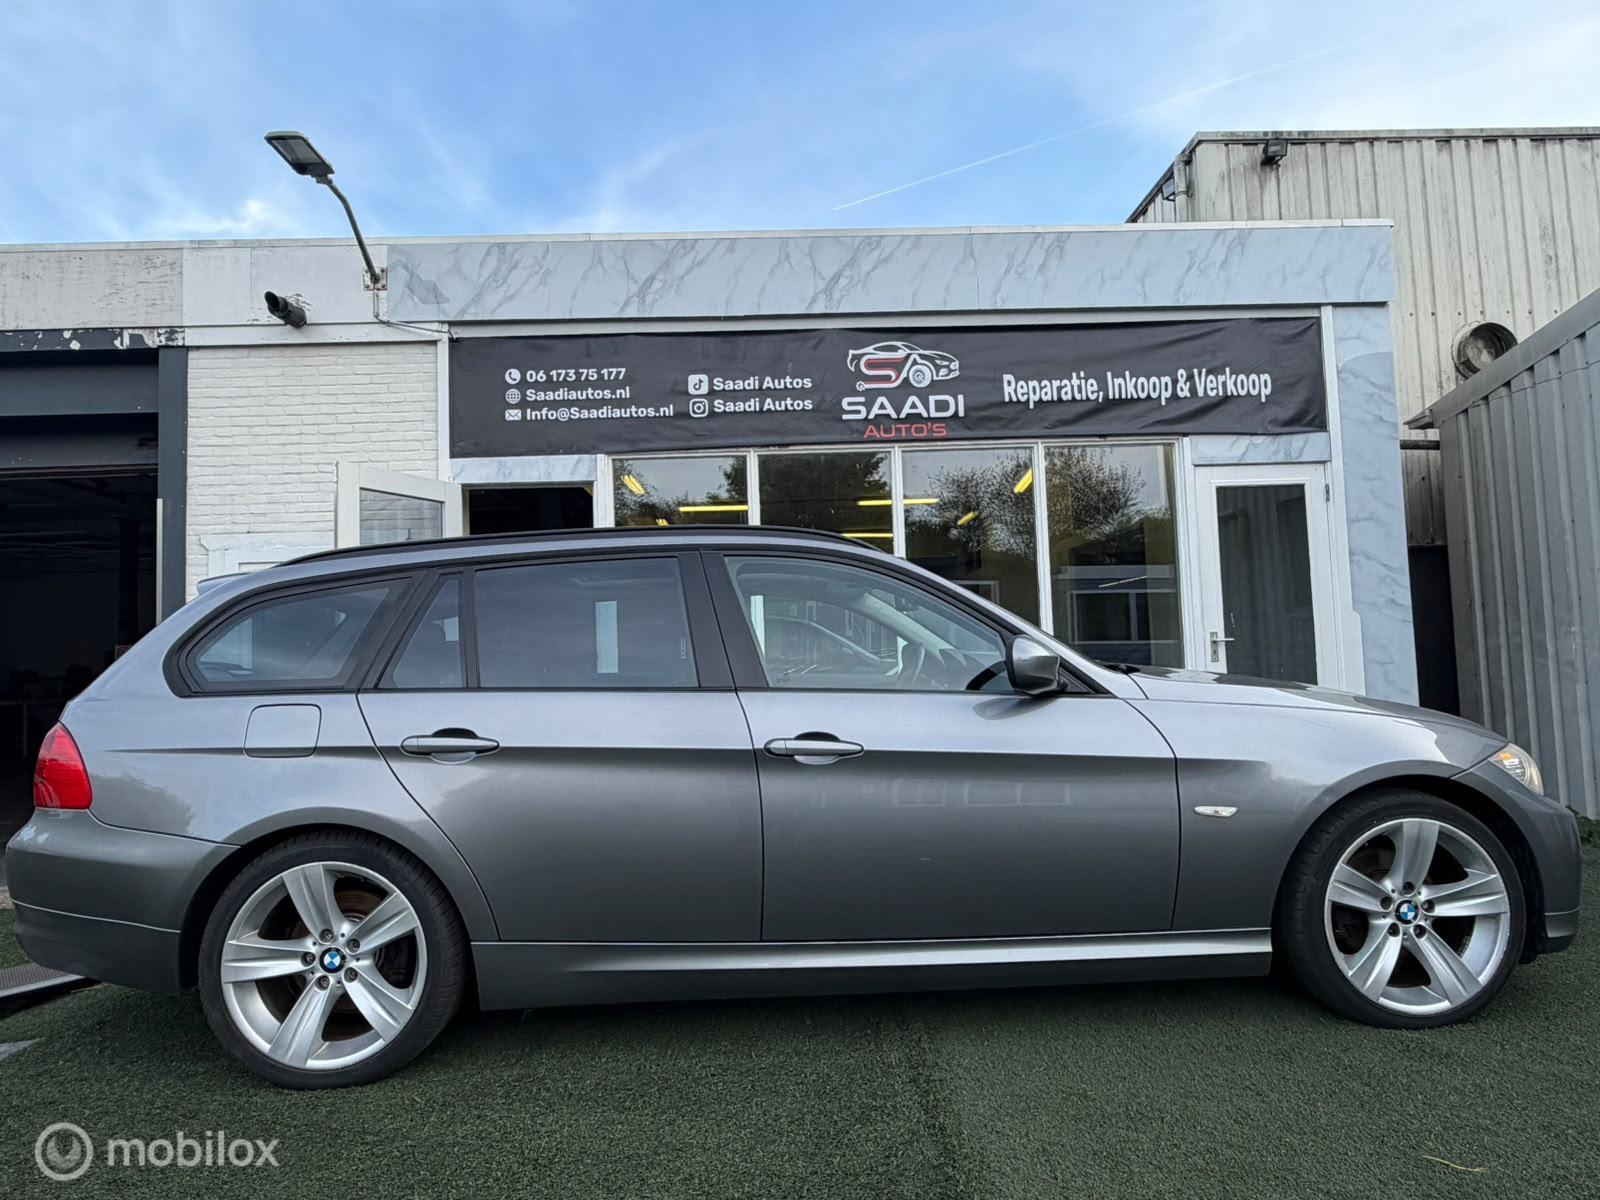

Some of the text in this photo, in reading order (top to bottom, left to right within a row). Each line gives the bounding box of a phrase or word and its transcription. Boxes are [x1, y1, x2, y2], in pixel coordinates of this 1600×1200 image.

[526, 367, 627, 383] 06 173 75 177
[712, 375, 813, 391] Saadi Autos
[525, 386, 631, 402] Saadiautos.nl
[1002, 366, 1272, 410] Reparatie, Inkoop & Verkoop
[526, 404, 674, 422] Info@Saadiautos.nl
[713, 396, 814, 413] Saadi Autos
[841, 393, 965, 420] SAADI
[864, 422, 947, 439] AUTO'S
